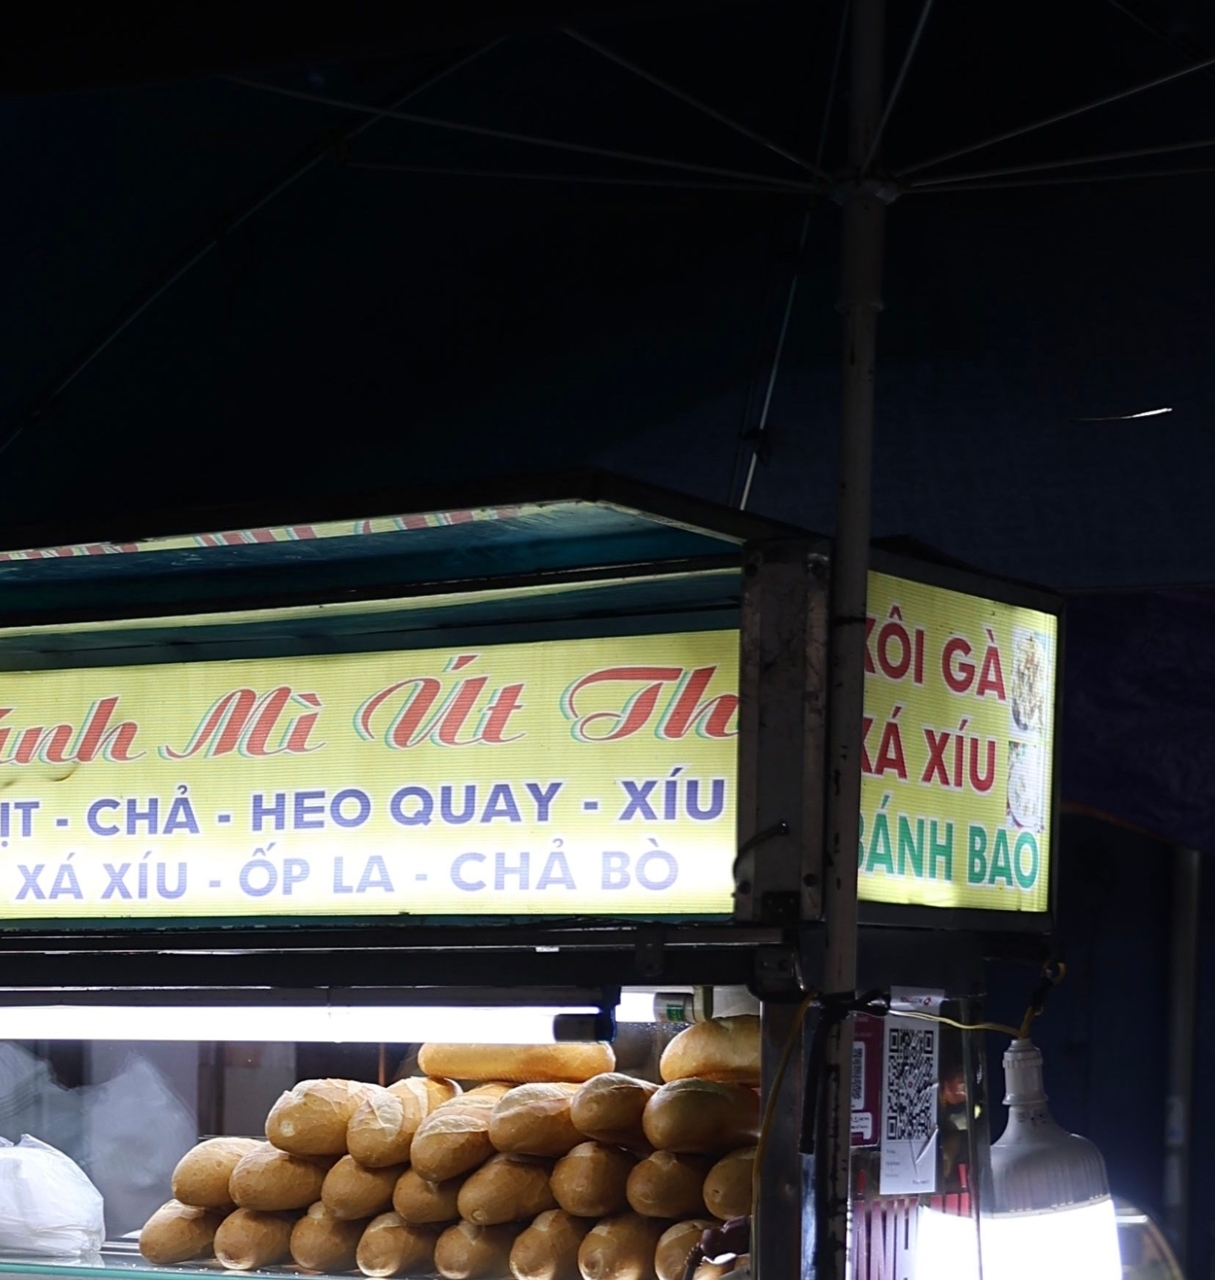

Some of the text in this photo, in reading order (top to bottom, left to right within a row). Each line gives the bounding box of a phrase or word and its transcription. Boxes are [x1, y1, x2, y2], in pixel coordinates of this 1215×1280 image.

[941, 628, 1007, 701] GÀ
[156, 686, 326, 758] Mì
[353, 654, 527, 750] Út
[921, 718, 997, 793] XÍU
[86, 784, 201, 836] CHẢ
[250, 788, 373, 832] HEO
[389, 781, 564, 827] QUAY
[617, 767, 726, 821] XÍU
[14, 851, 84, 900] XÁ
[100, 850, 188, 900] XÍU
[238, 841, 312, 898] ỐP
[332, 854, 396, 895] LA
[449, 838, 577, 892] CHẢ
[600, 837, 680, 892] BÒ
[858, 794, 1040, 889] ÁNH BAO
